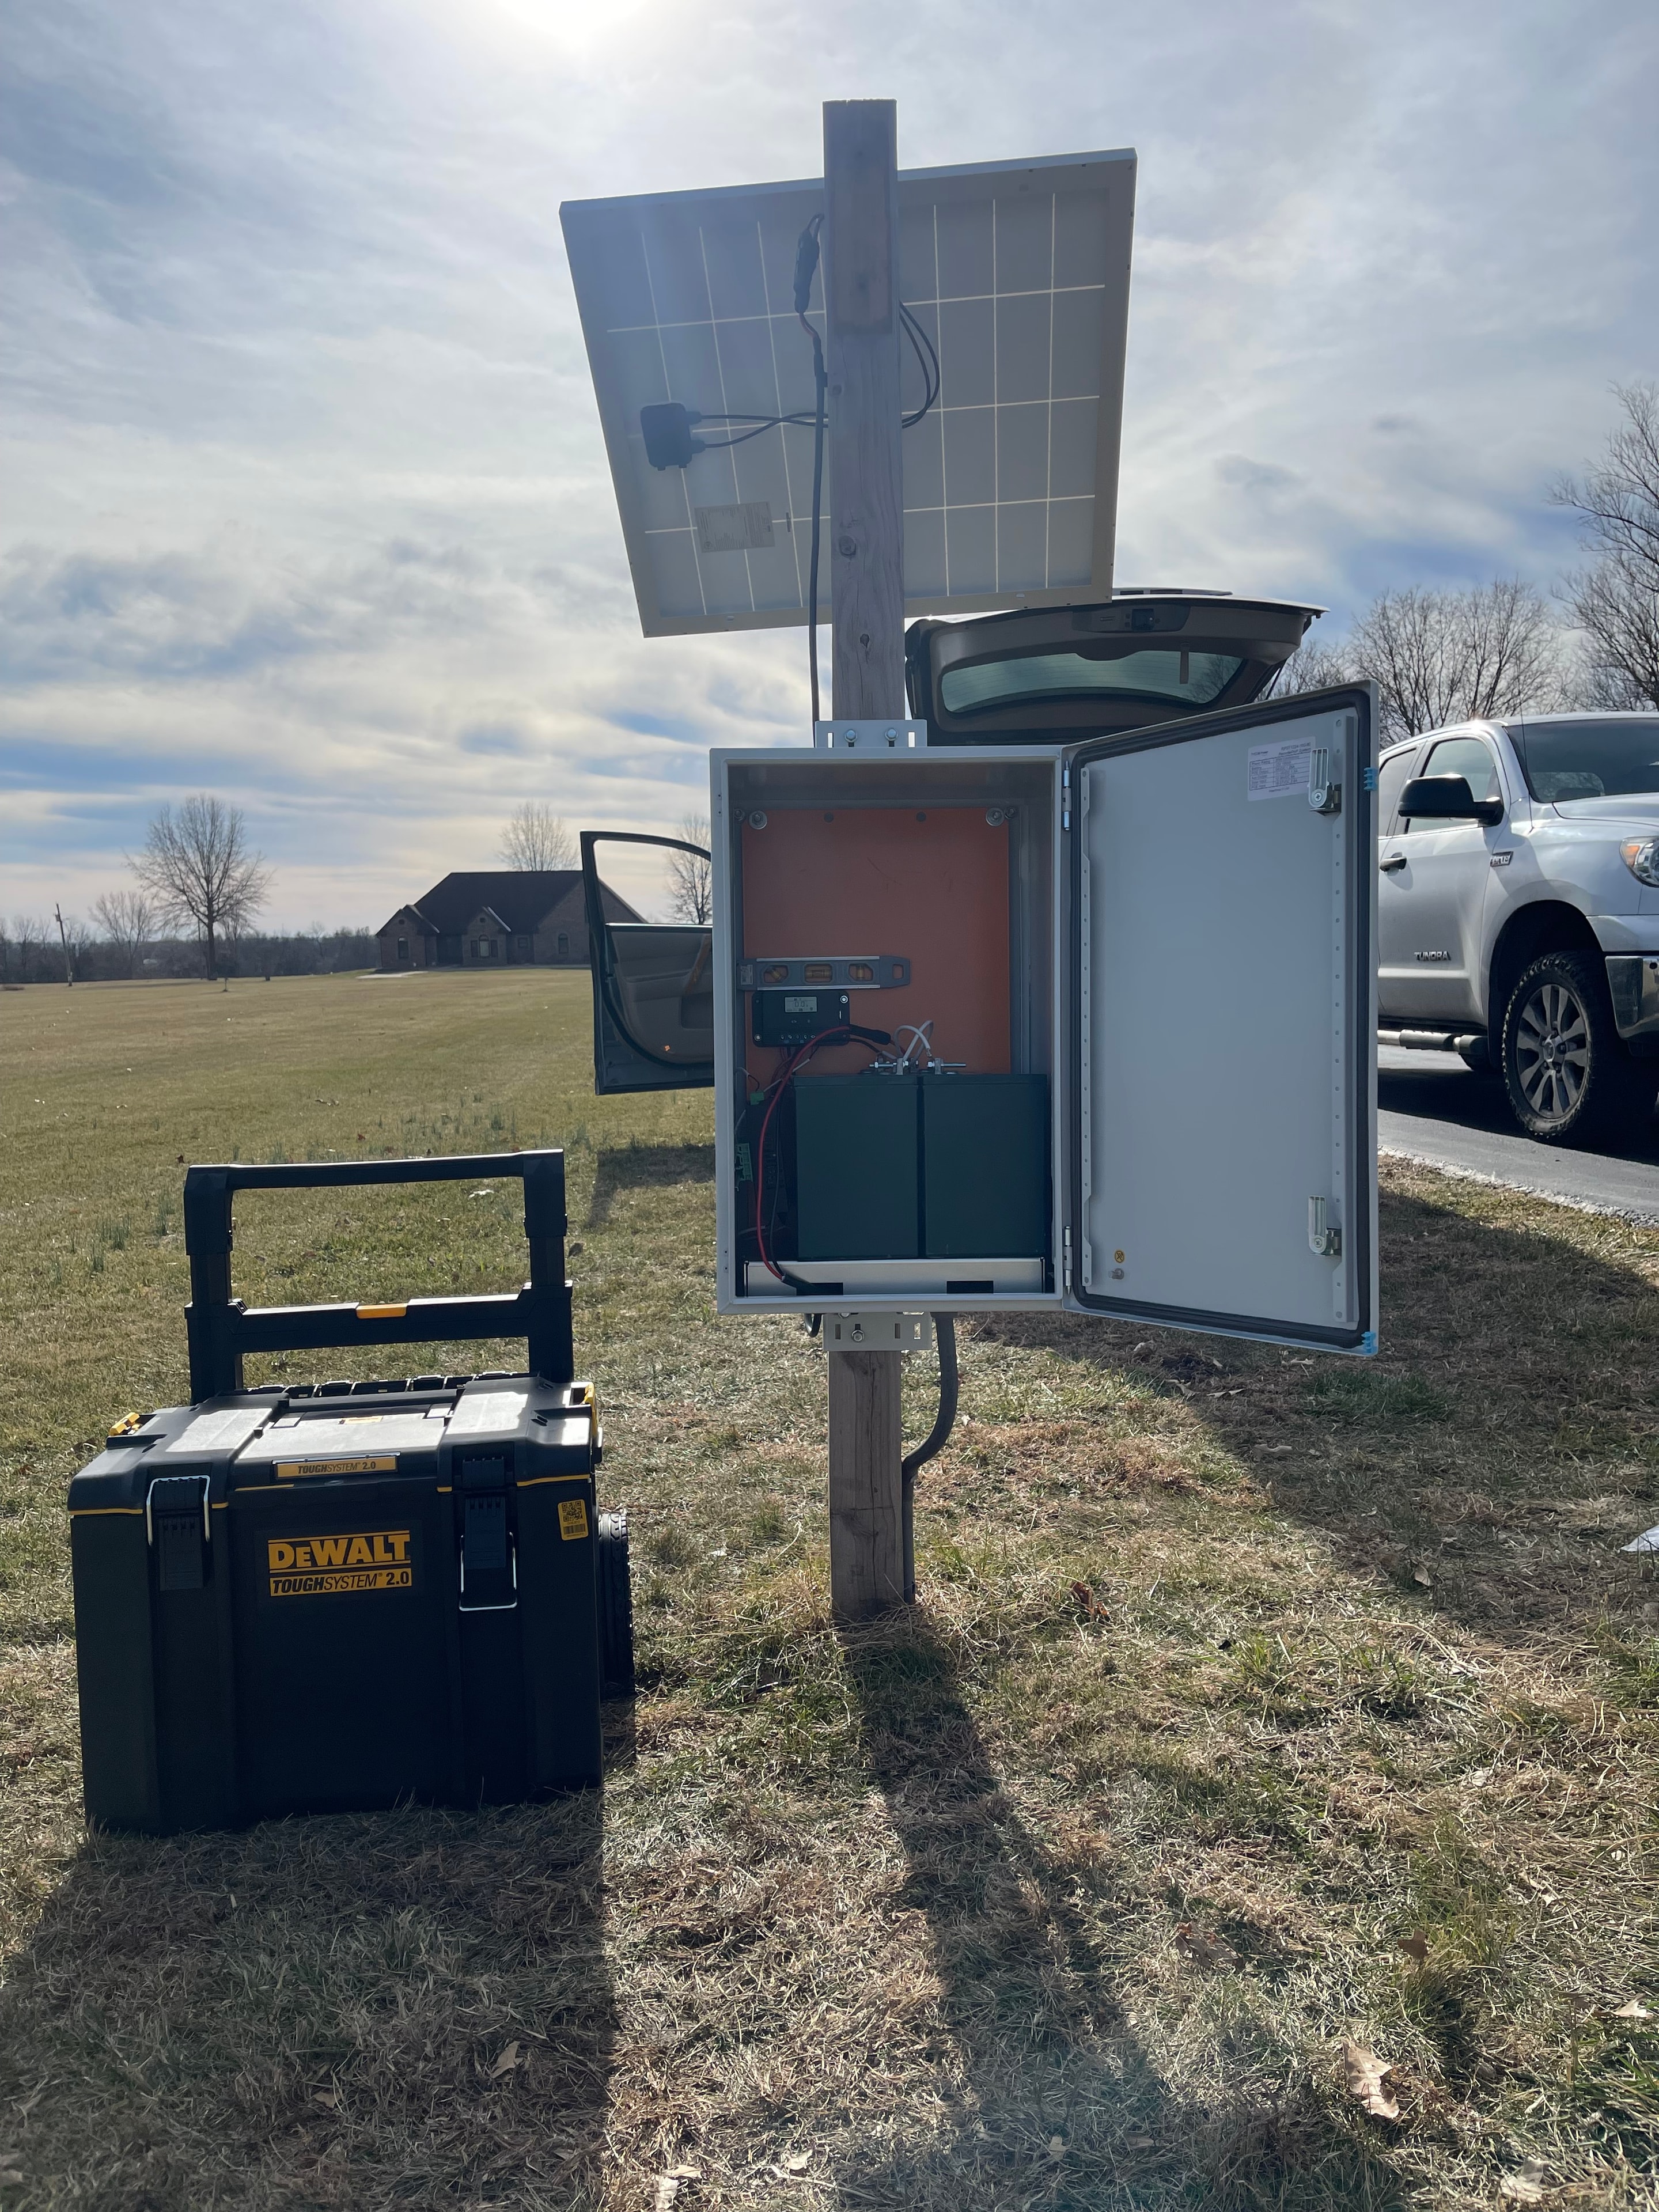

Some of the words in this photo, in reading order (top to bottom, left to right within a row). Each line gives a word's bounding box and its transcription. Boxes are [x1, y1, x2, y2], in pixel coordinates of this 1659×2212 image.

[1414, 950, 1449, 961] TUNDRA
[362, 1461, 377, 1471] 2.0
[268, 1535, 411, 1570] DEWALT
[385, 1570, 410, 1586] 2.0
